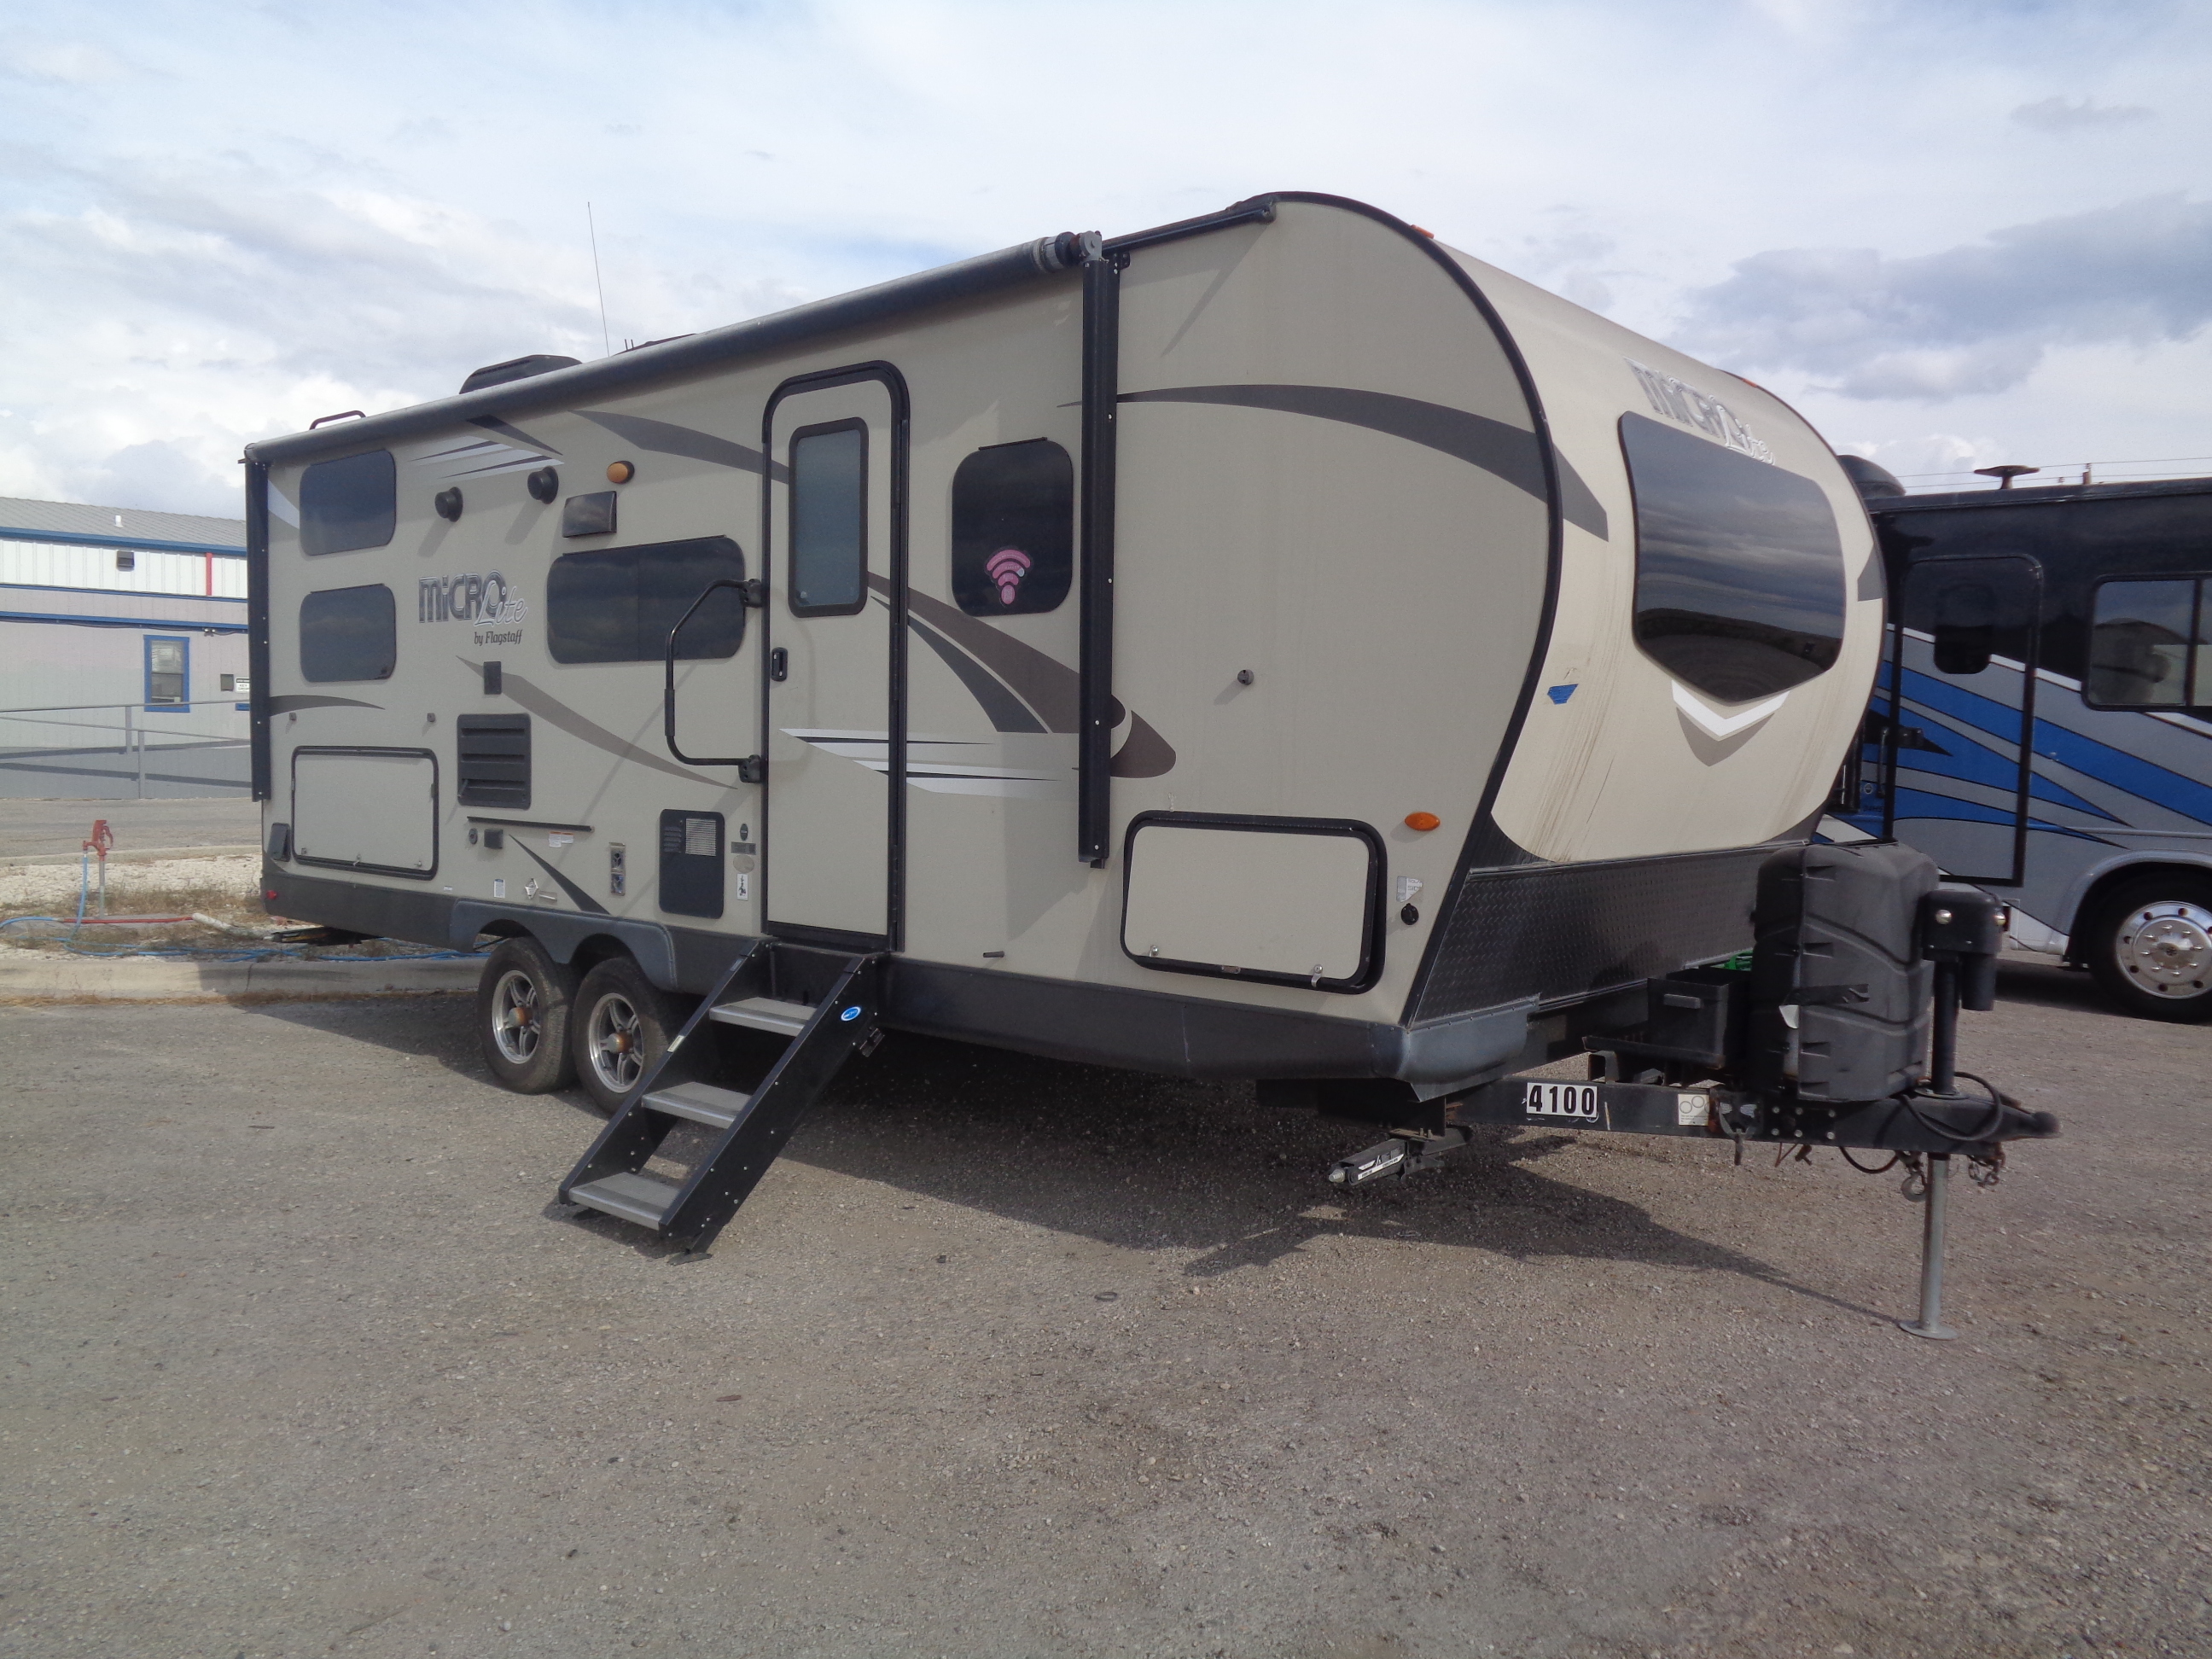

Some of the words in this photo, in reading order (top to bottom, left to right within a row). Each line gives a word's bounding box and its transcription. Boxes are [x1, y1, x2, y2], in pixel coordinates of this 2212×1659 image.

[474, 580, 527, 626] Lite
[474, 632, 484, 646] by
[486, 629, 522, 645] Flagstaff
[1528, 1085, 1595, 1116] 4100
